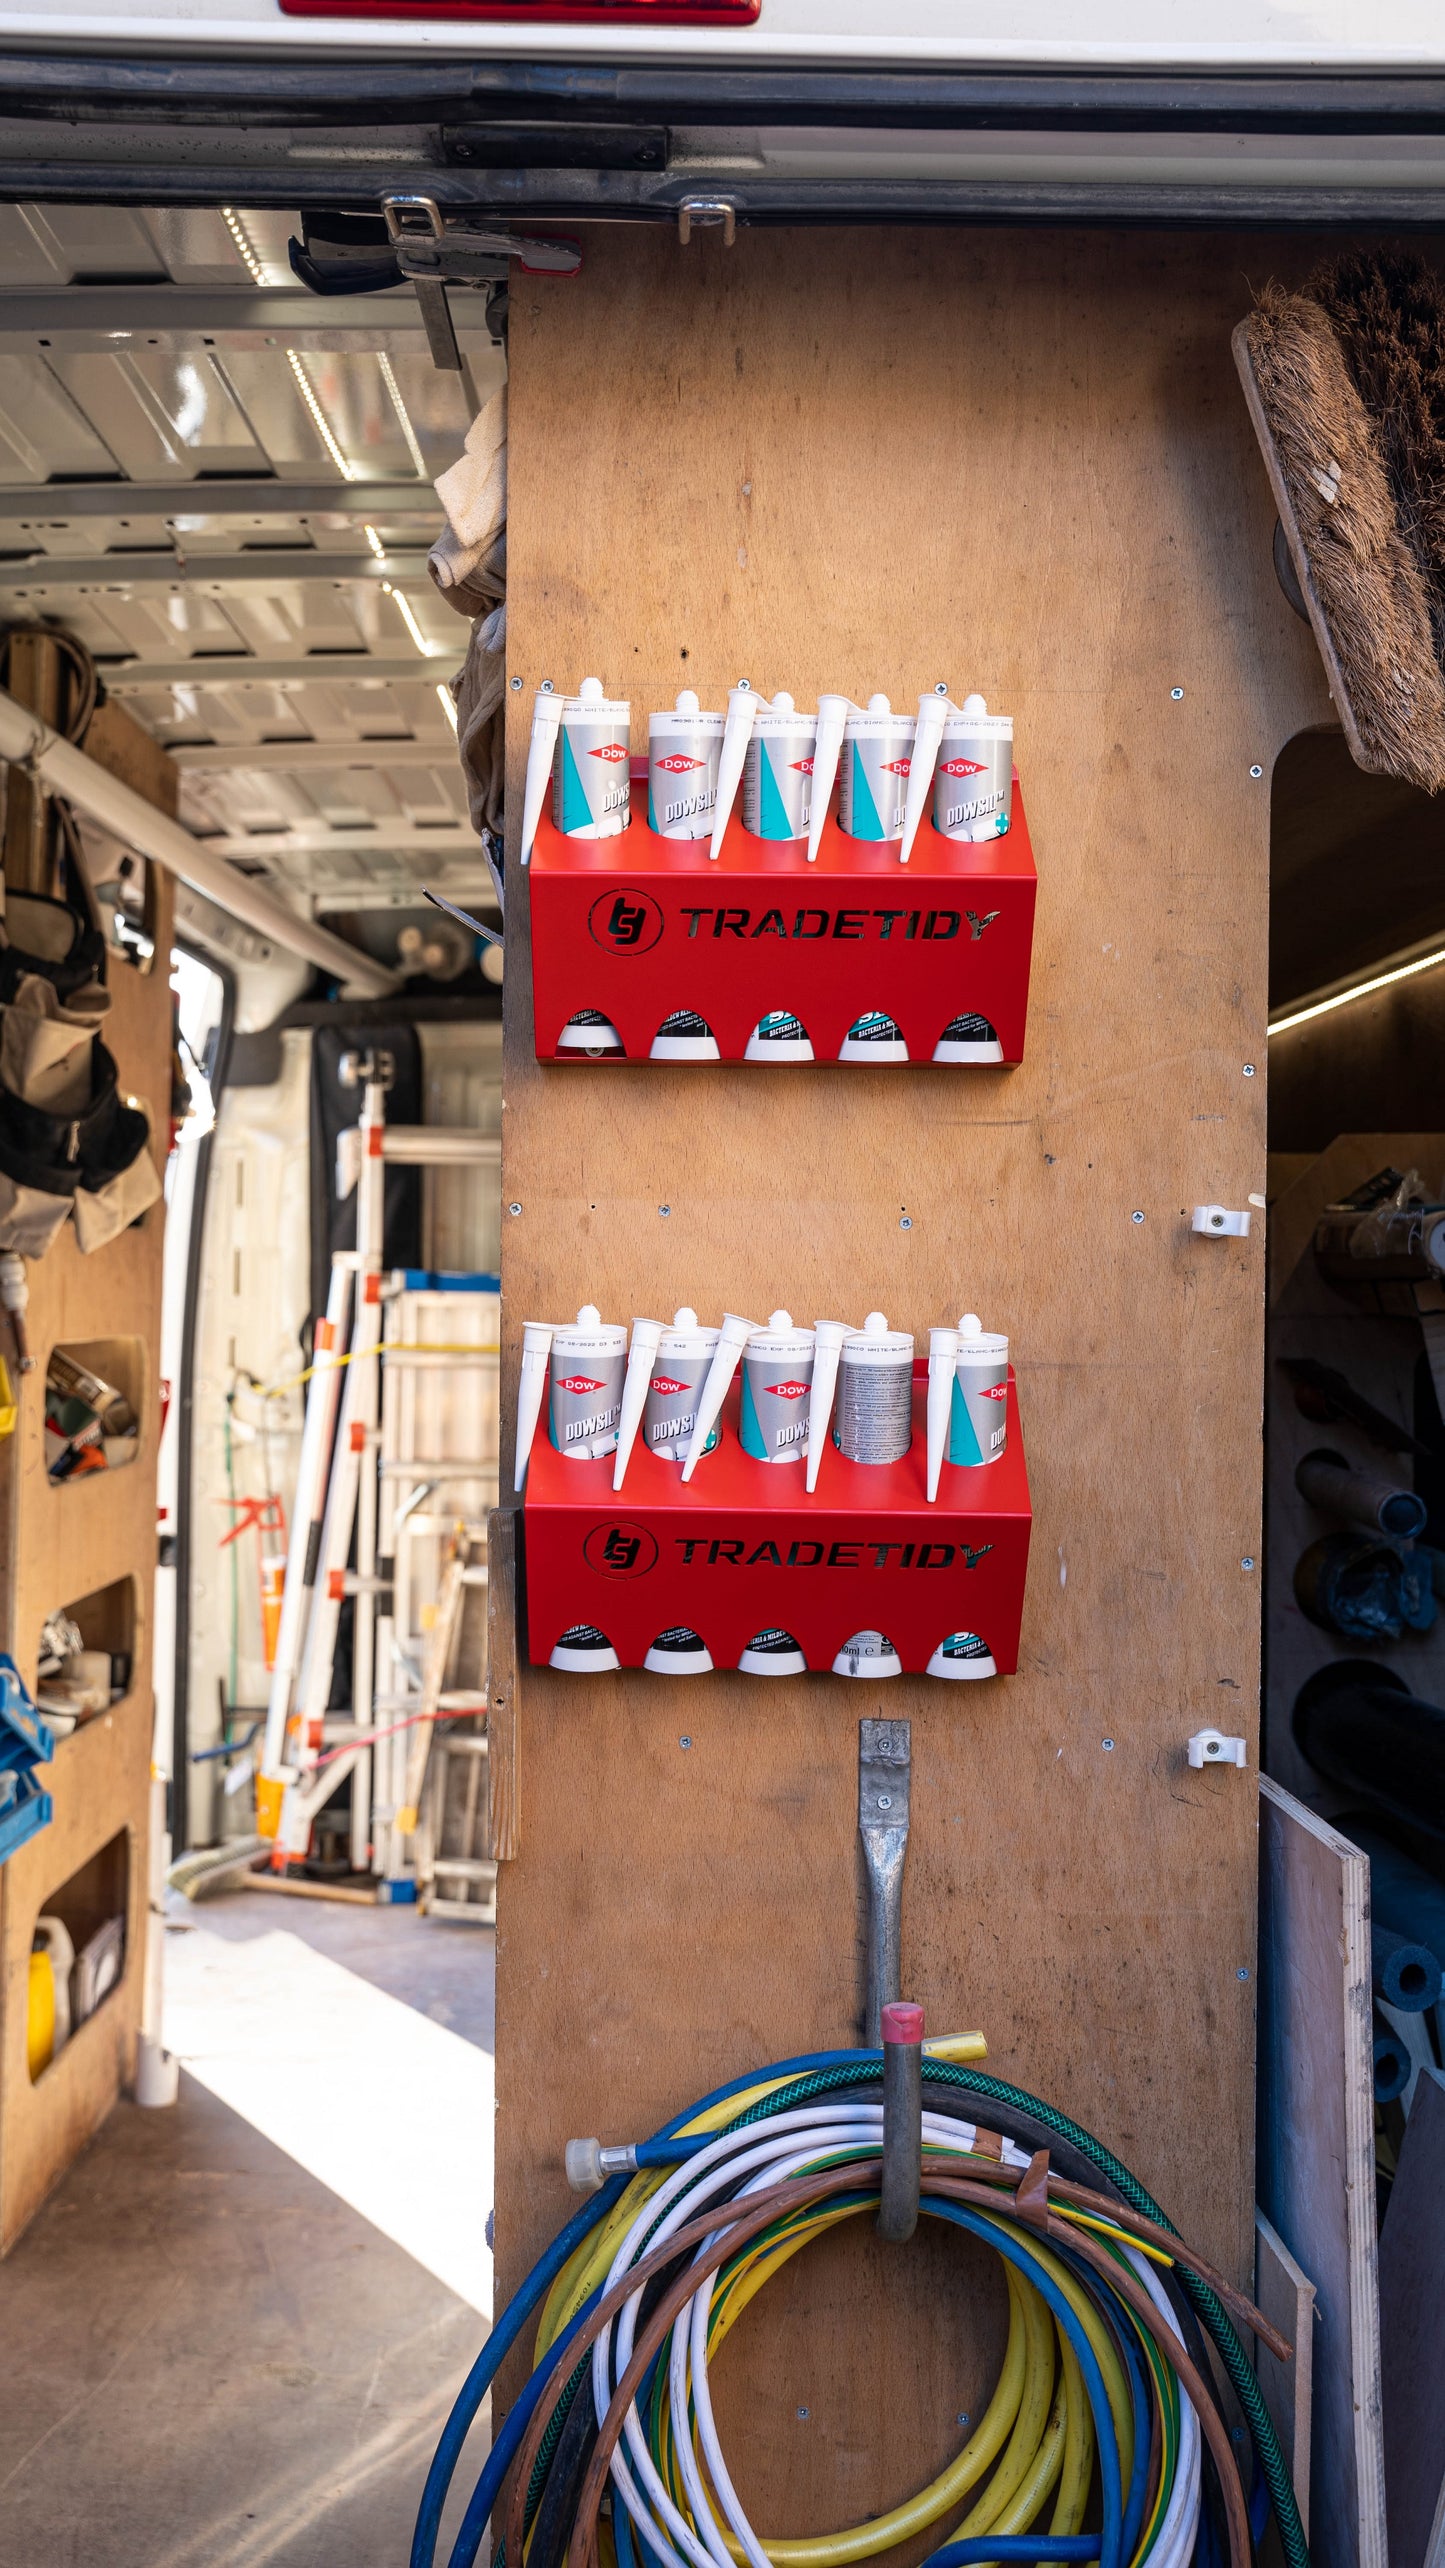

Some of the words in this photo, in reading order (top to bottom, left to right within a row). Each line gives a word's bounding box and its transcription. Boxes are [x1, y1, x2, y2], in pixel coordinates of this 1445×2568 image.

[893, 763, 911, 772] DO
[680, 908, 1000, 941] TRADETIDY
[675, 1539, 996, 1571] TRADETIDY
